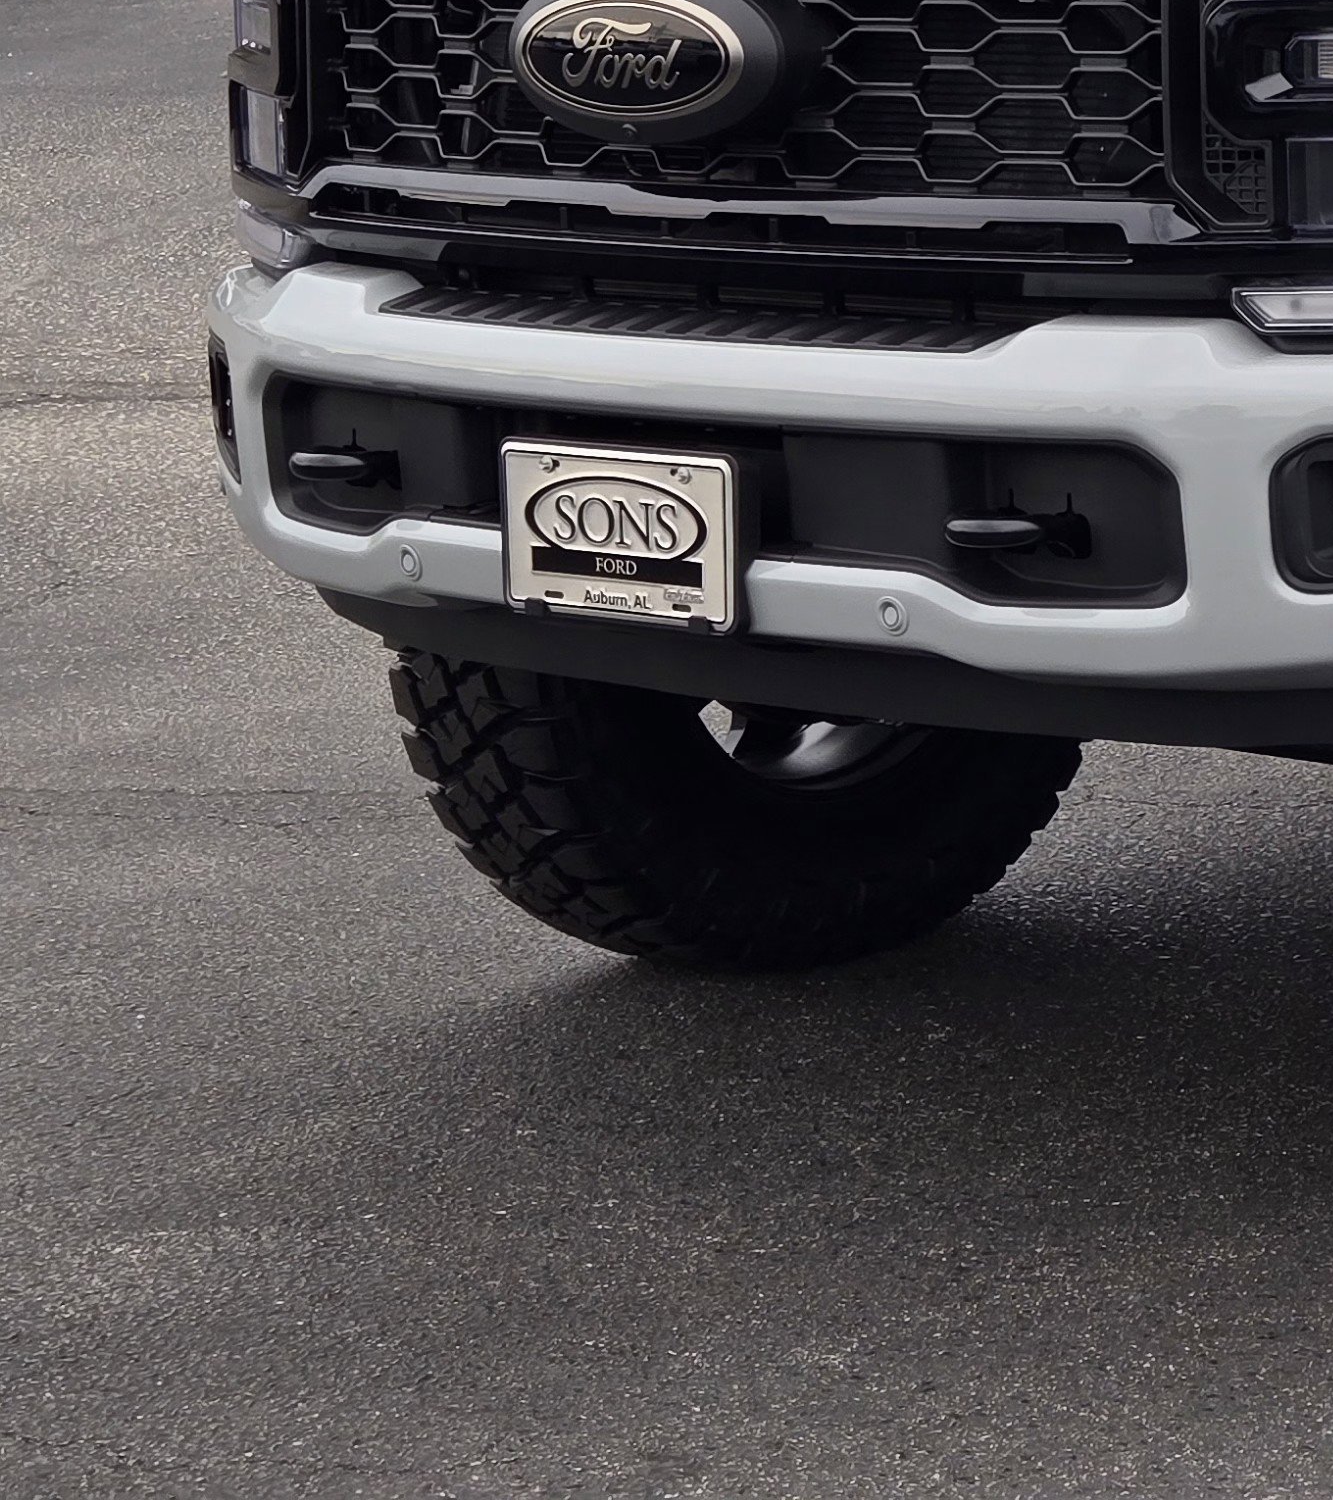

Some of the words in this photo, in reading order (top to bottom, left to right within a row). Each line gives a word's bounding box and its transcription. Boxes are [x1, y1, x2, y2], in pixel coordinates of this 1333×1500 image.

[561, 17, 682, 91] Ford
[553, 492, 679, 552] SONS
[595, 556, 638, 576] FORD
[583, 588, 632, 610] Auburn,
[633, 594, 652, 610] AL
